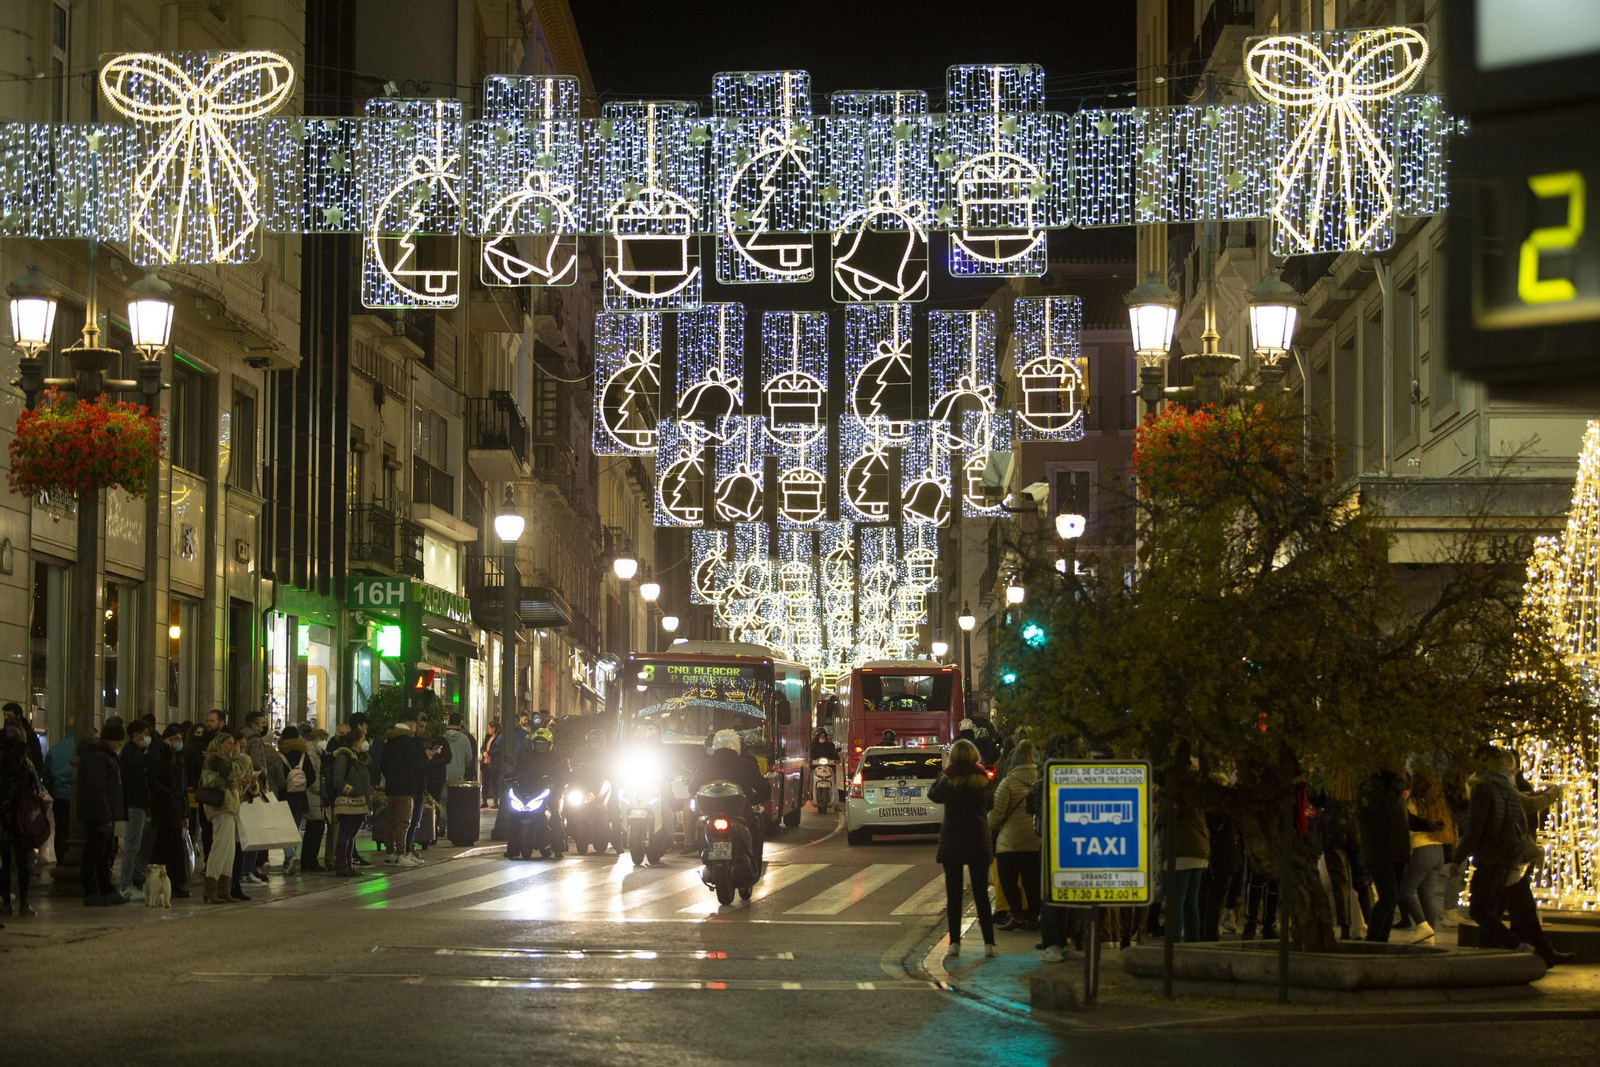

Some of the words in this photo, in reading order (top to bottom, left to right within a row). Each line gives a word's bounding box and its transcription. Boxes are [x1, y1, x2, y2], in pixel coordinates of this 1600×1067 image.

[1517, 170, 1586, 304] 2
[353, 581, 405, 605] 16H
[420, 583, 472, 624] FARMACIA
[693, 666, 740, 676] ALFACAR
[901, 698, 913, 708] 33
[1071, 836, 1126, 855] TAXI
[1057, 889, 1069, 899] DE
[1094, 889, 1101, 899] A
